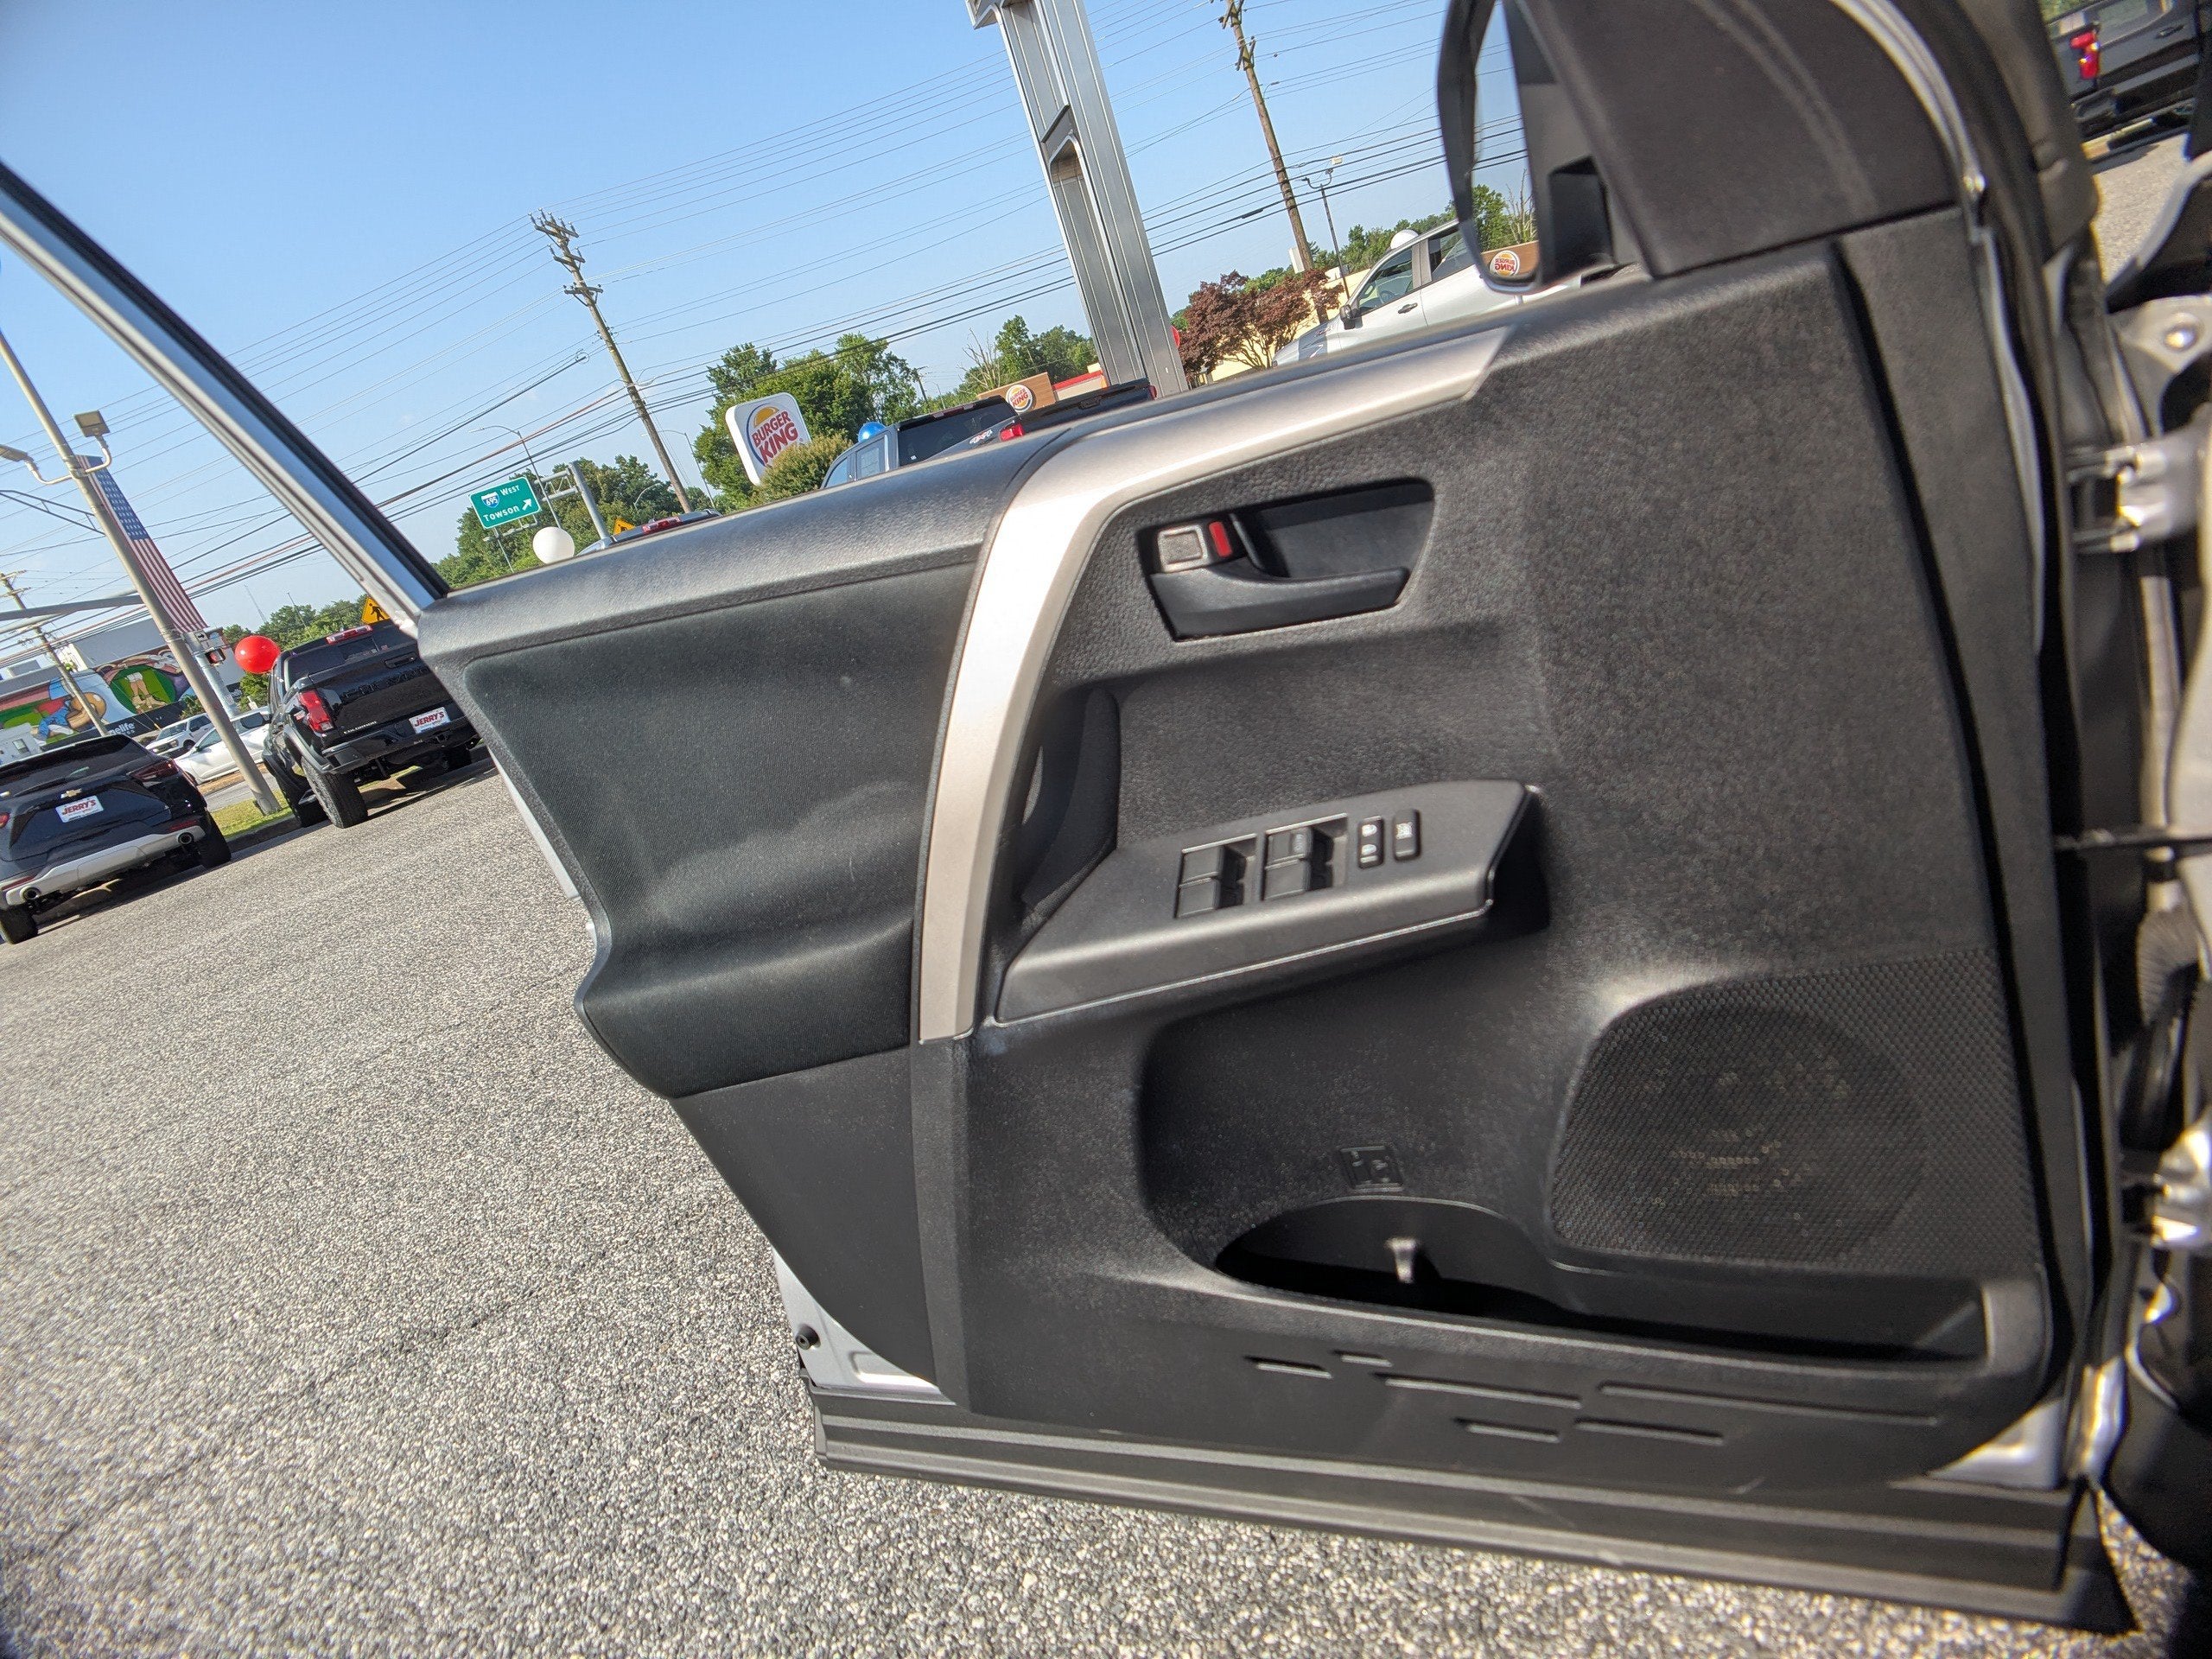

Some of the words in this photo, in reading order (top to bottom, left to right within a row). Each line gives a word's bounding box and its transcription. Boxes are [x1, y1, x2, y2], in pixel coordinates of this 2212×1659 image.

[1012, 391, 1029, 407] KING
[752, 410, 791, 448] BURGER
[759, 422, 798, 464] KING
[486, 496, 499, 506] 695
[415, 711, 445, 727] JERRY'S
[108, 722, 135, 735] nelife
[61, 799, 96, 815] JERRY'S
